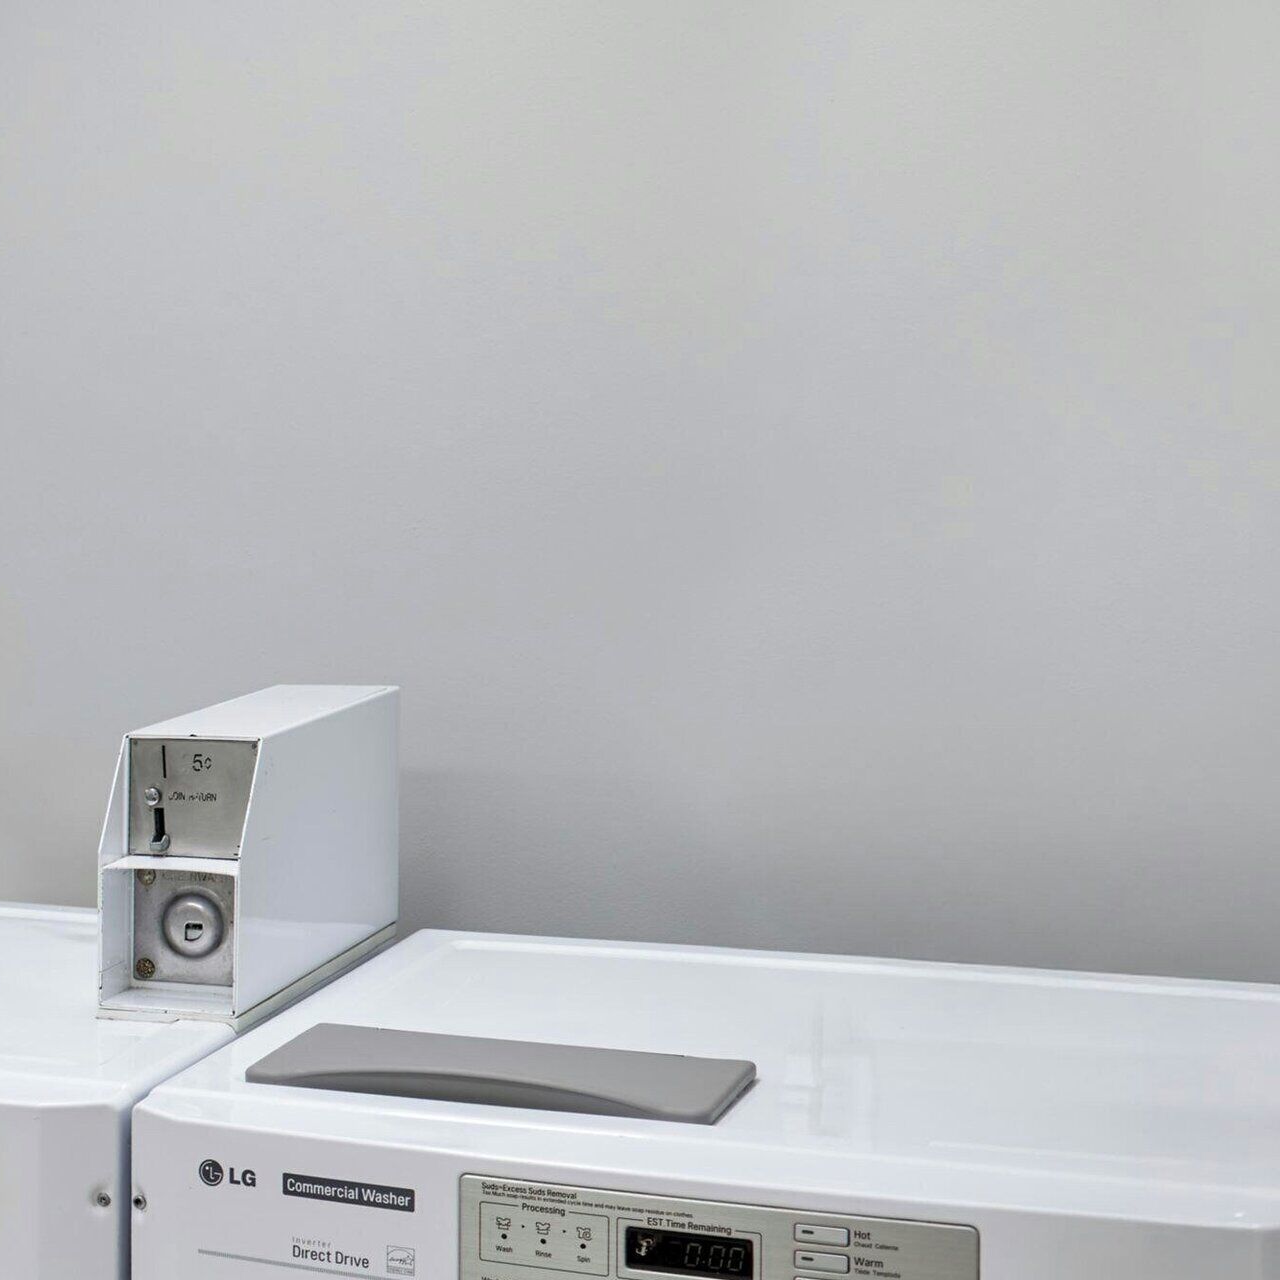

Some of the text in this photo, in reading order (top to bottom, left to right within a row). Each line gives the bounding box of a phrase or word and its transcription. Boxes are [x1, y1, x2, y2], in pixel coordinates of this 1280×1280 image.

[229, 1167, 411, 1207] LG Commercial Washer
[528, 1187, 546, 1197] Suds
[547, 1190, 577, 1200] Removal
[522, 1203, 566, 1217] Processing
[647, 1217, 732, 1235] EST Time Remaining
[854, 1230, 871, 1240] Hot
[496, 1245, 513, 1253] Wash
[535, 1250, 552, 1258] Rinse
[292, 1245, 331, 1264] Direct
[335, 1251, 370, 1268] Drive
[577, 1255, 590, 1264] Spin
[854, 1257, 883, 1268] Warm
